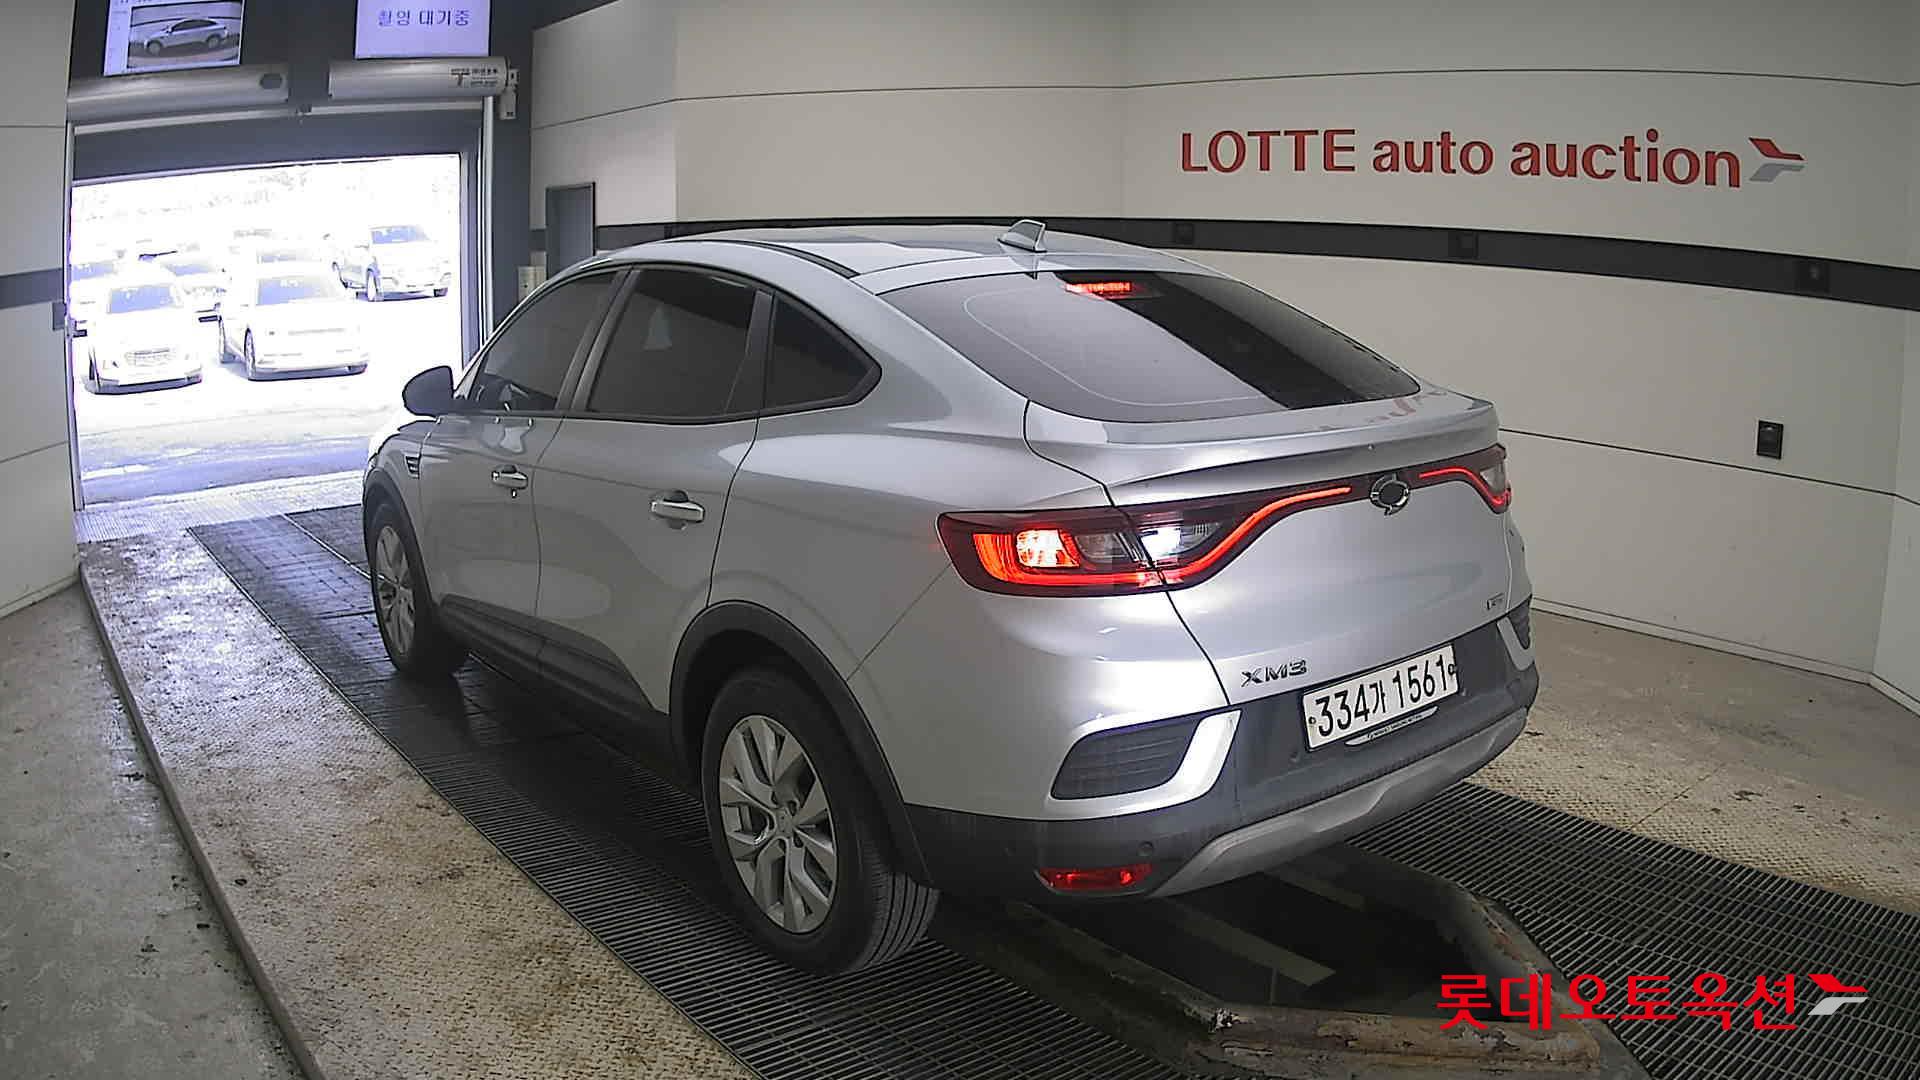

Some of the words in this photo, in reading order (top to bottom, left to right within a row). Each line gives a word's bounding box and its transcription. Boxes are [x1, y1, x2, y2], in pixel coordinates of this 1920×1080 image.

[419, 9, 469, 26] 대기중
[1181, 129, 1357, 173] LOTTE
[1372, 131, 1494, 175] auto
[1510, 129, 1740, 188] auction
[1240, 659, 1308, 688] XM3
[1314, 679, 1387, 737] 334가
[1392, 654, 1448, 709] 1561
